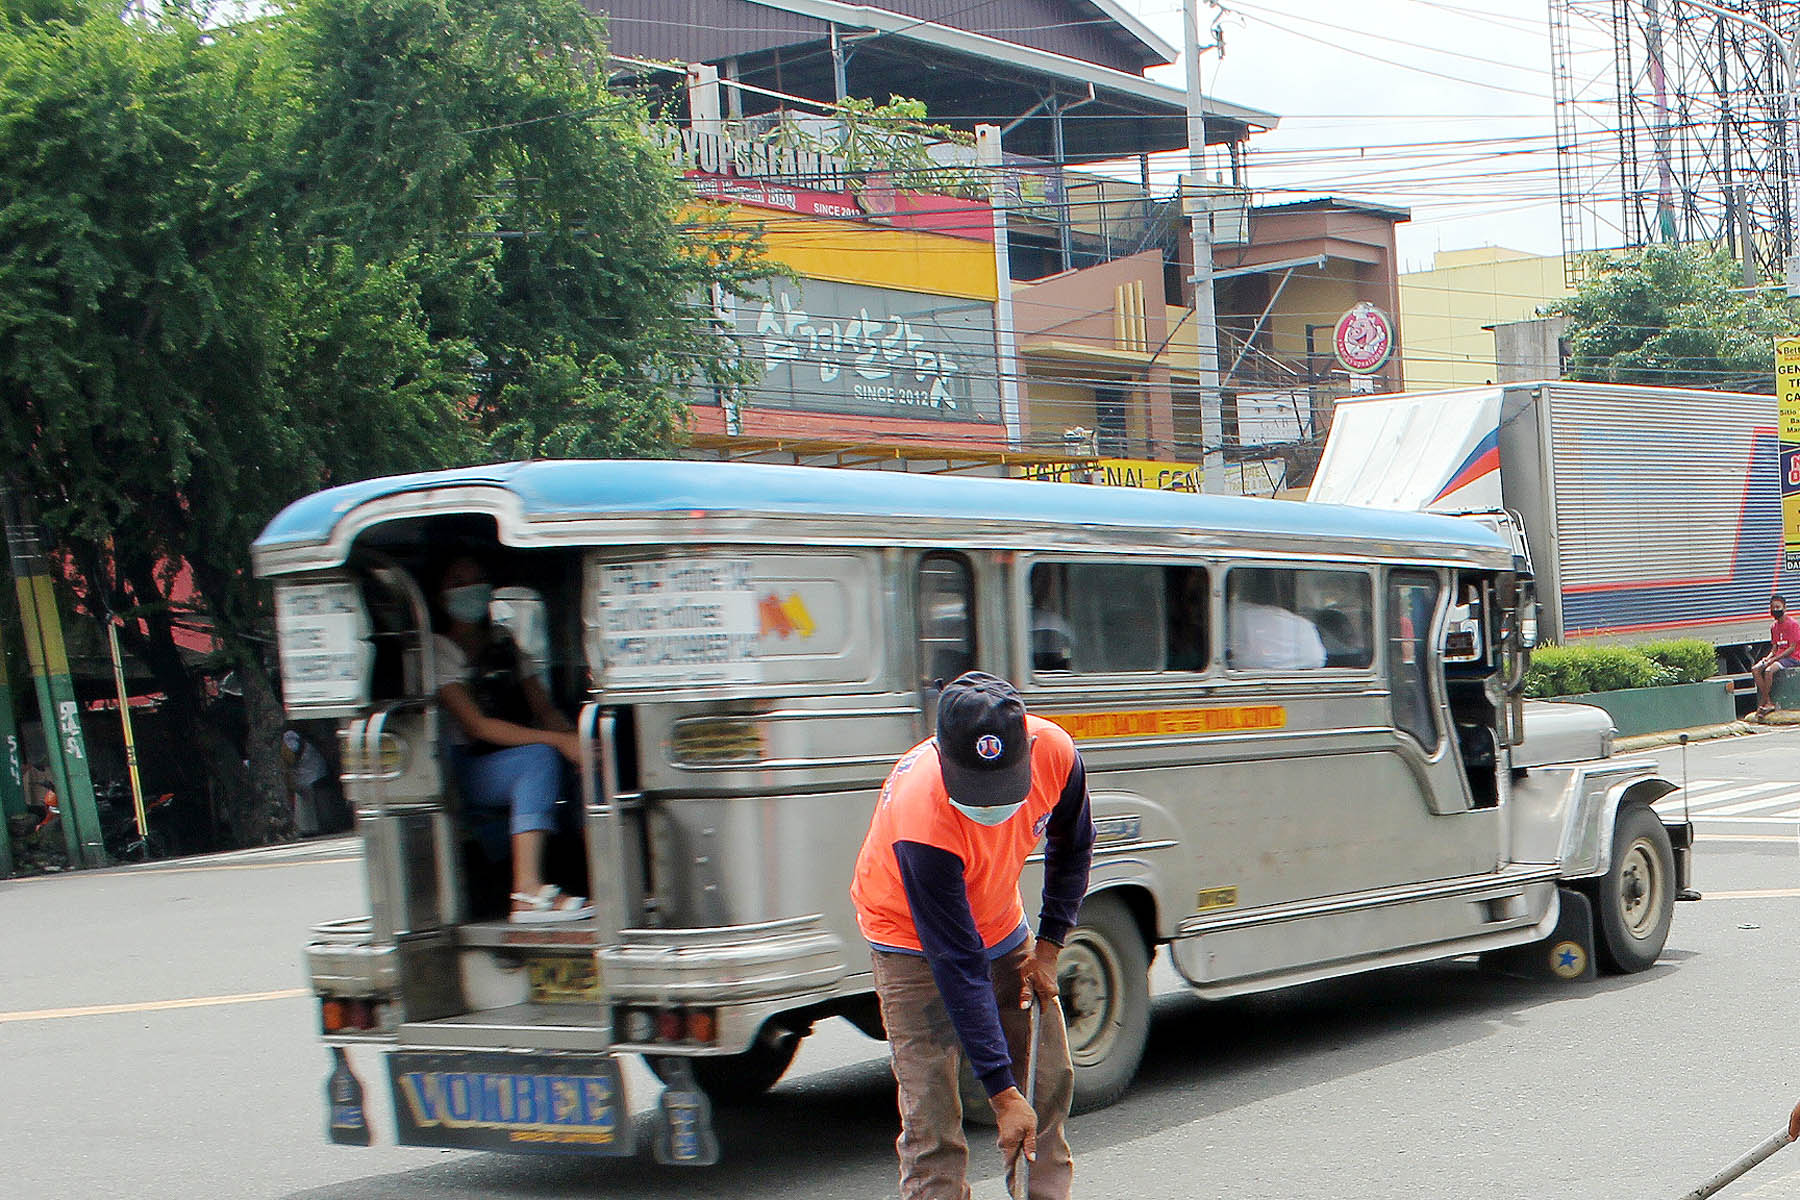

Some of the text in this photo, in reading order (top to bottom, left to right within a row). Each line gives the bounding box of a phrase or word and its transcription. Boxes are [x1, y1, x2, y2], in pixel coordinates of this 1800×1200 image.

[767, 187, 796, 210] BBQ
[813, 202, 841, 218] SINCE
[853, 384, 931, 407] SINCE 2012
